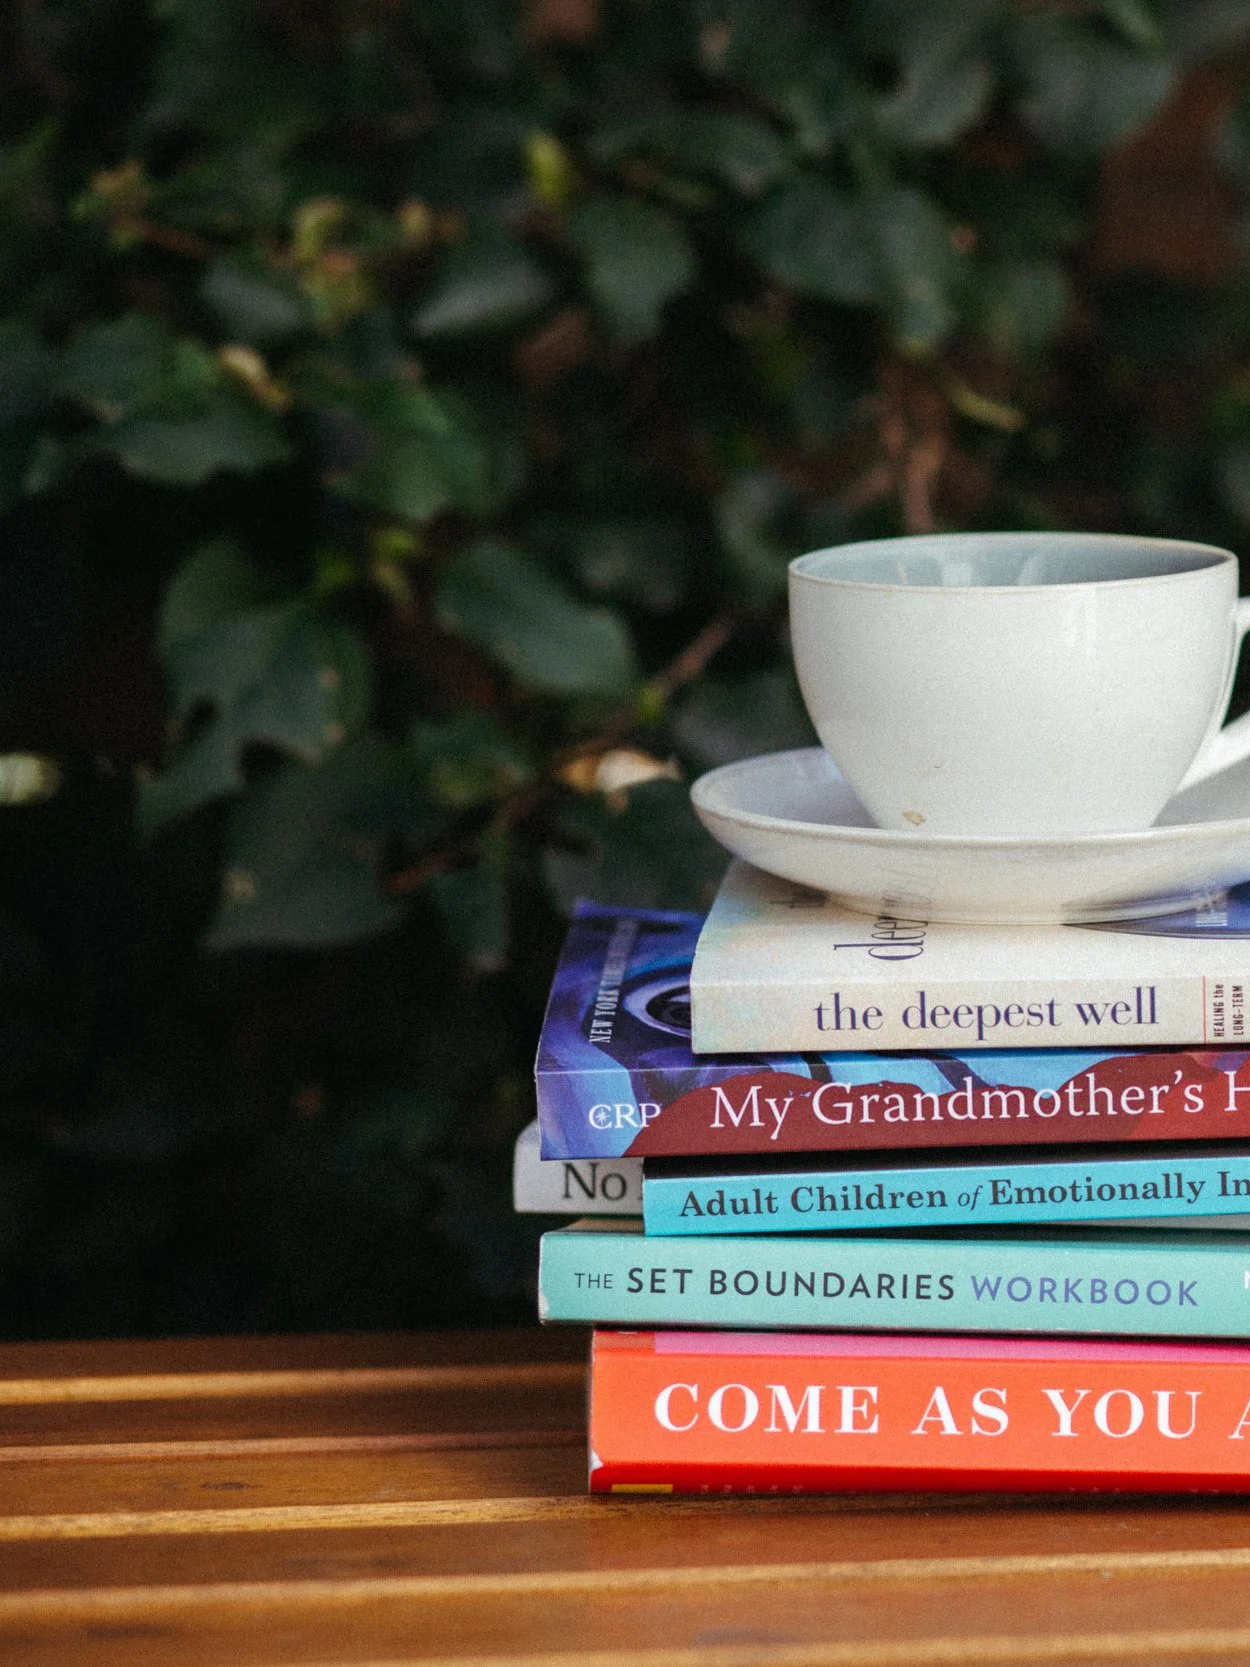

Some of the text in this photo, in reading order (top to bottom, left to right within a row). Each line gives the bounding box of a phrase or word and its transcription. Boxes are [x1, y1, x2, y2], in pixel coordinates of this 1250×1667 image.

[594, 988, 620, 1016] YORK
[814, 985, 1159, 1041] the deepest well
[1213, 984, 1225, 1037] HEALING the
[1232, 985, 1244, 1036] LONG-TERM
[588, 1019, 612, 1043] NEW
[588, 1103, 661, 1130] CRP
[710, 1083, 795, 1140] My
[811, 1071, 1206, 1126] Grandmother's
[563, 1162, 627, 1200] No
[679, 1188, 779, 1218] Adult
[790, 1183, 948, 1214] Children
[957, 1184, 985, 1209] of
[989, 1173, 1206, 1207] Emotionally
[574, 1267, 1199, 1307] THE SET BOUNDARIES WORKBOOK
[654, 1382, 880, 1435] COME
[911, 1385, 1010, 1437] AS
[1041, 1388, 1203, 1439] YOU
